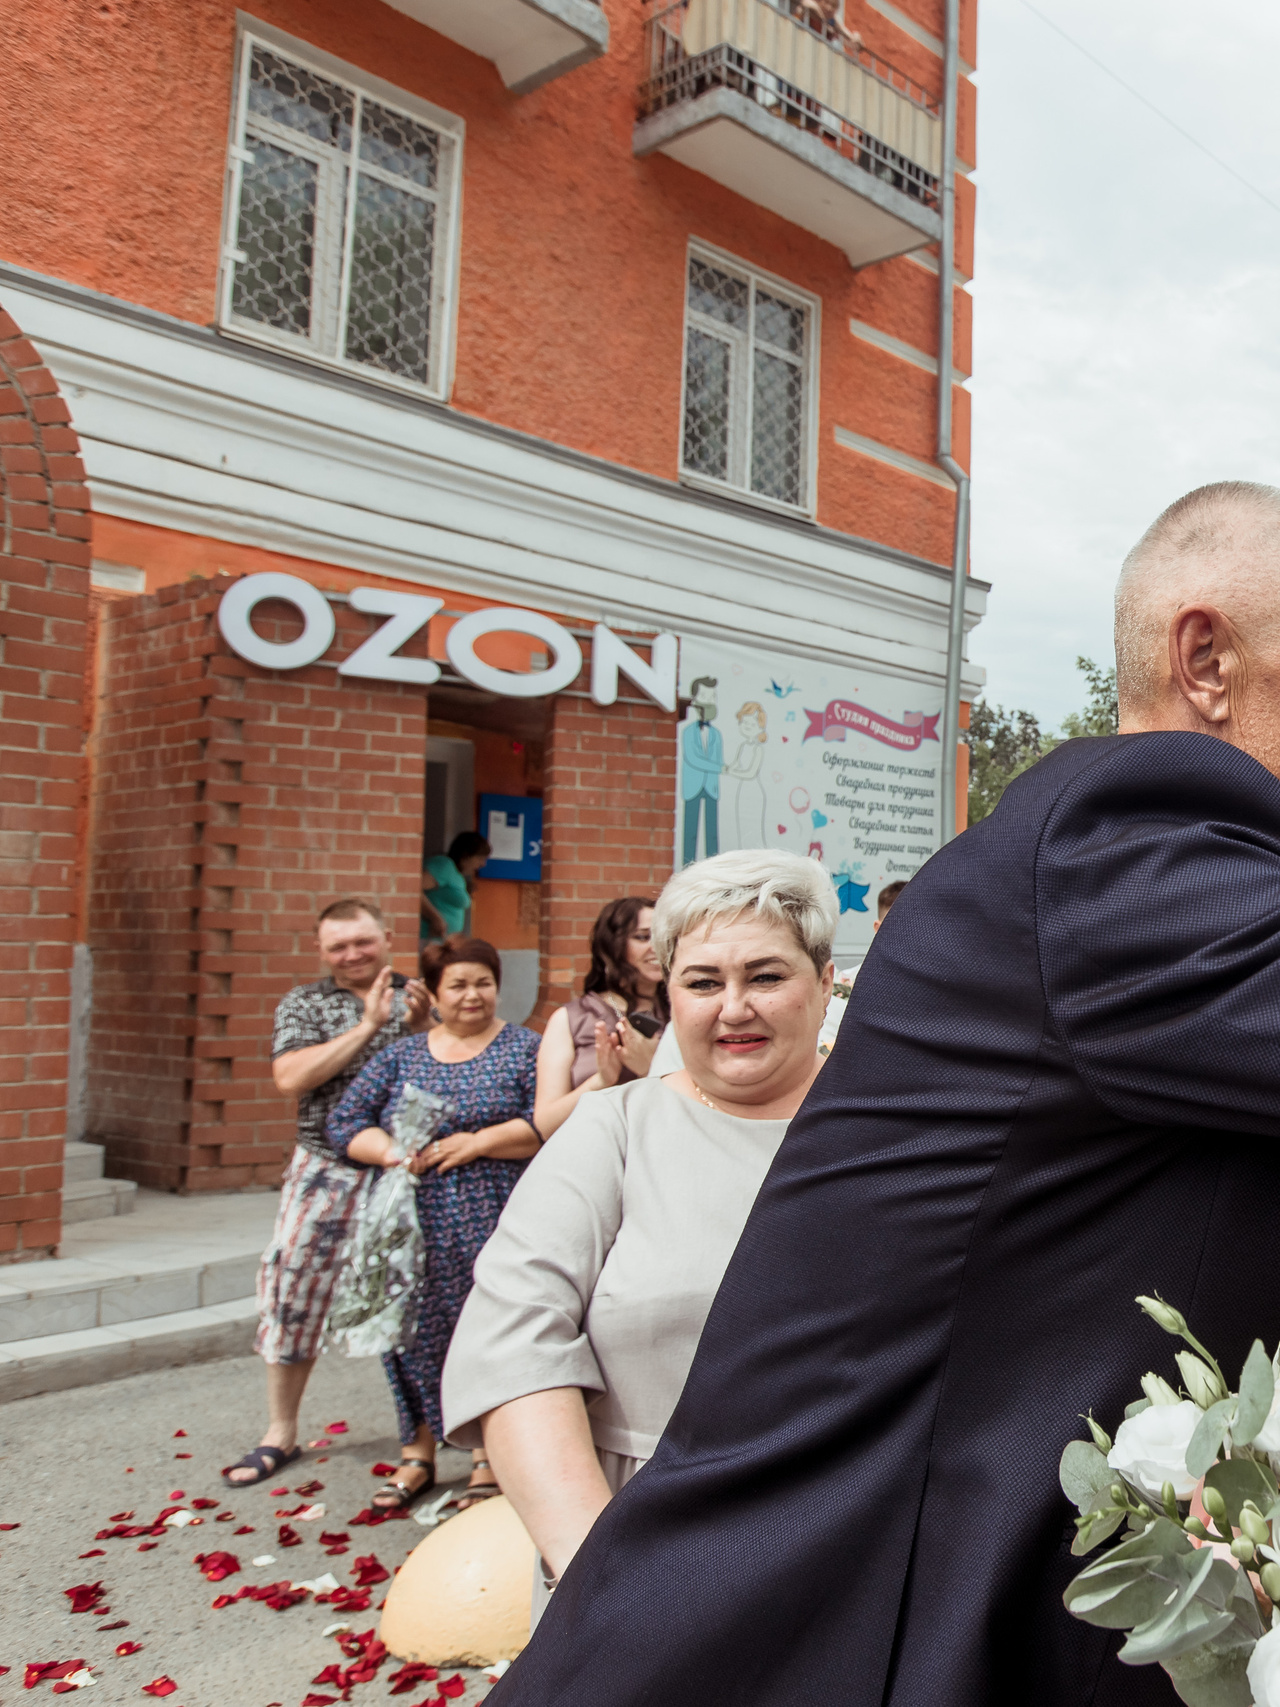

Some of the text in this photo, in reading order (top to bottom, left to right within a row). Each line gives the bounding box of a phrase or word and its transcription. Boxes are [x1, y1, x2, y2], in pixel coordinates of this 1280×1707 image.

[218, 571, 678, 713] OZON
[834, 702, 915, 746] Студия праздника
[822, 751, 936, 779] Оформление торжеств
[836, 773, 935, 801] Свадебная продукция
[824, 792, 934, 820] Товары для праздника
[848, 816, 934, 836] Свадебные платья
[853, 837, 933, 860] Воздушные шары
